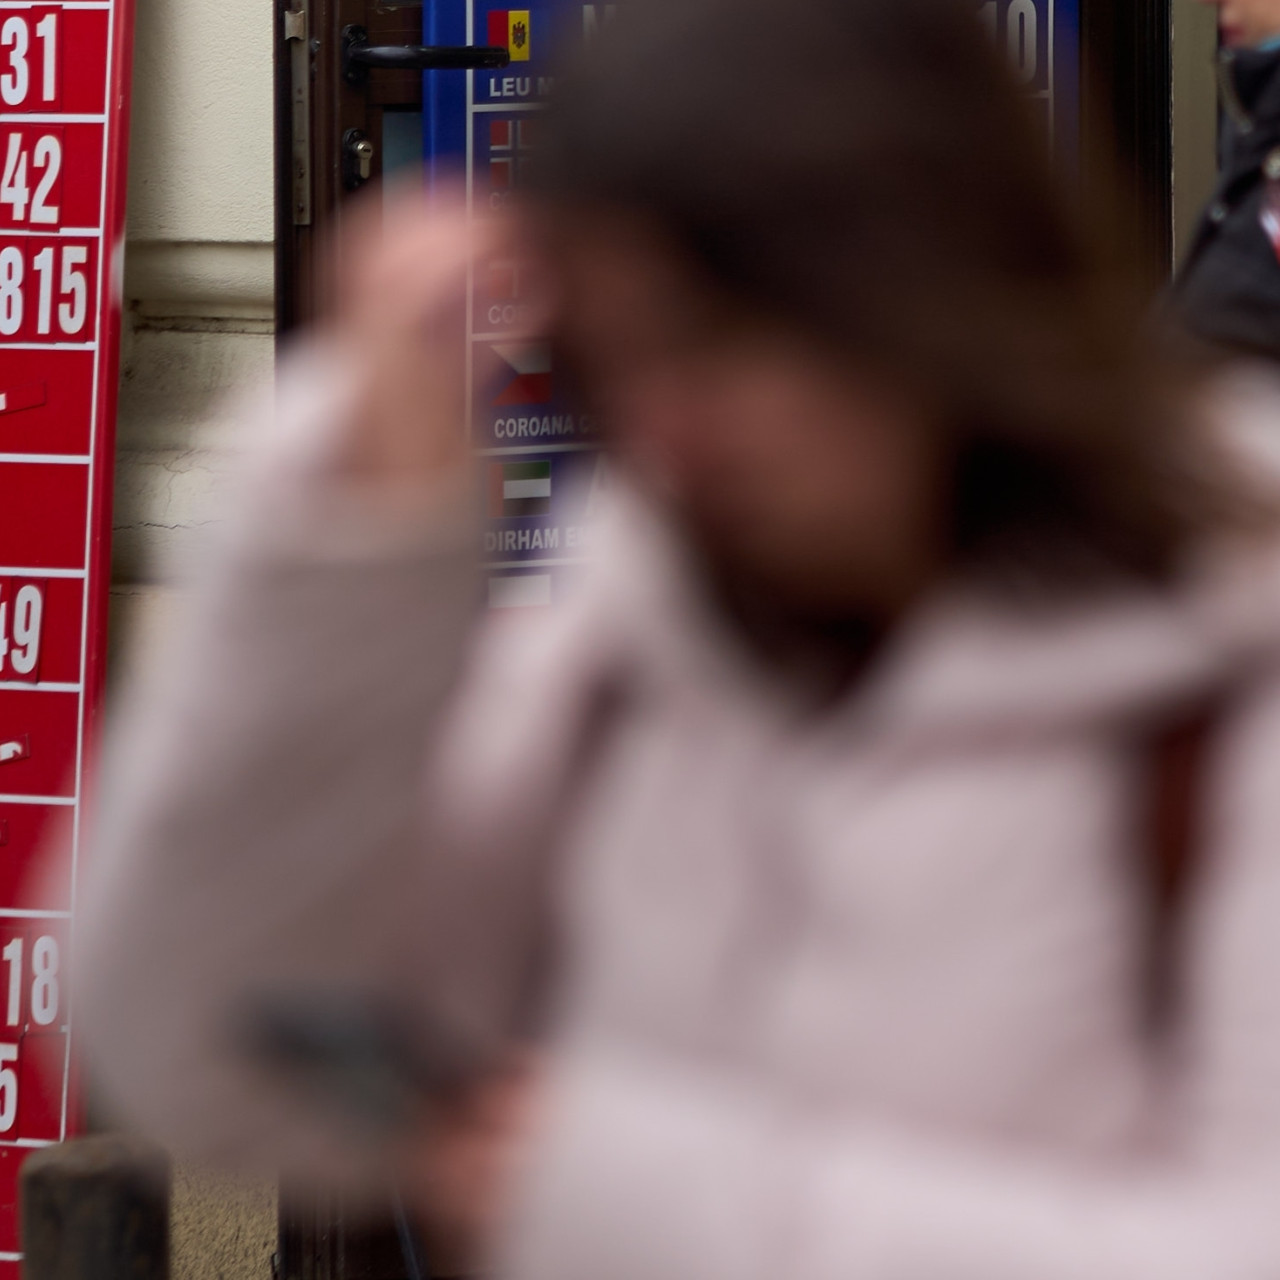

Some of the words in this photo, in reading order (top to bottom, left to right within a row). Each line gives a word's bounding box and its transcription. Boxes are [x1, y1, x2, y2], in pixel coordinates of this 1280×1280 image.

[490, 78, 530, 97] LEU
[494, 415, 574, 438] COROANA
[484, 528, 559, 552] DIRHAM
